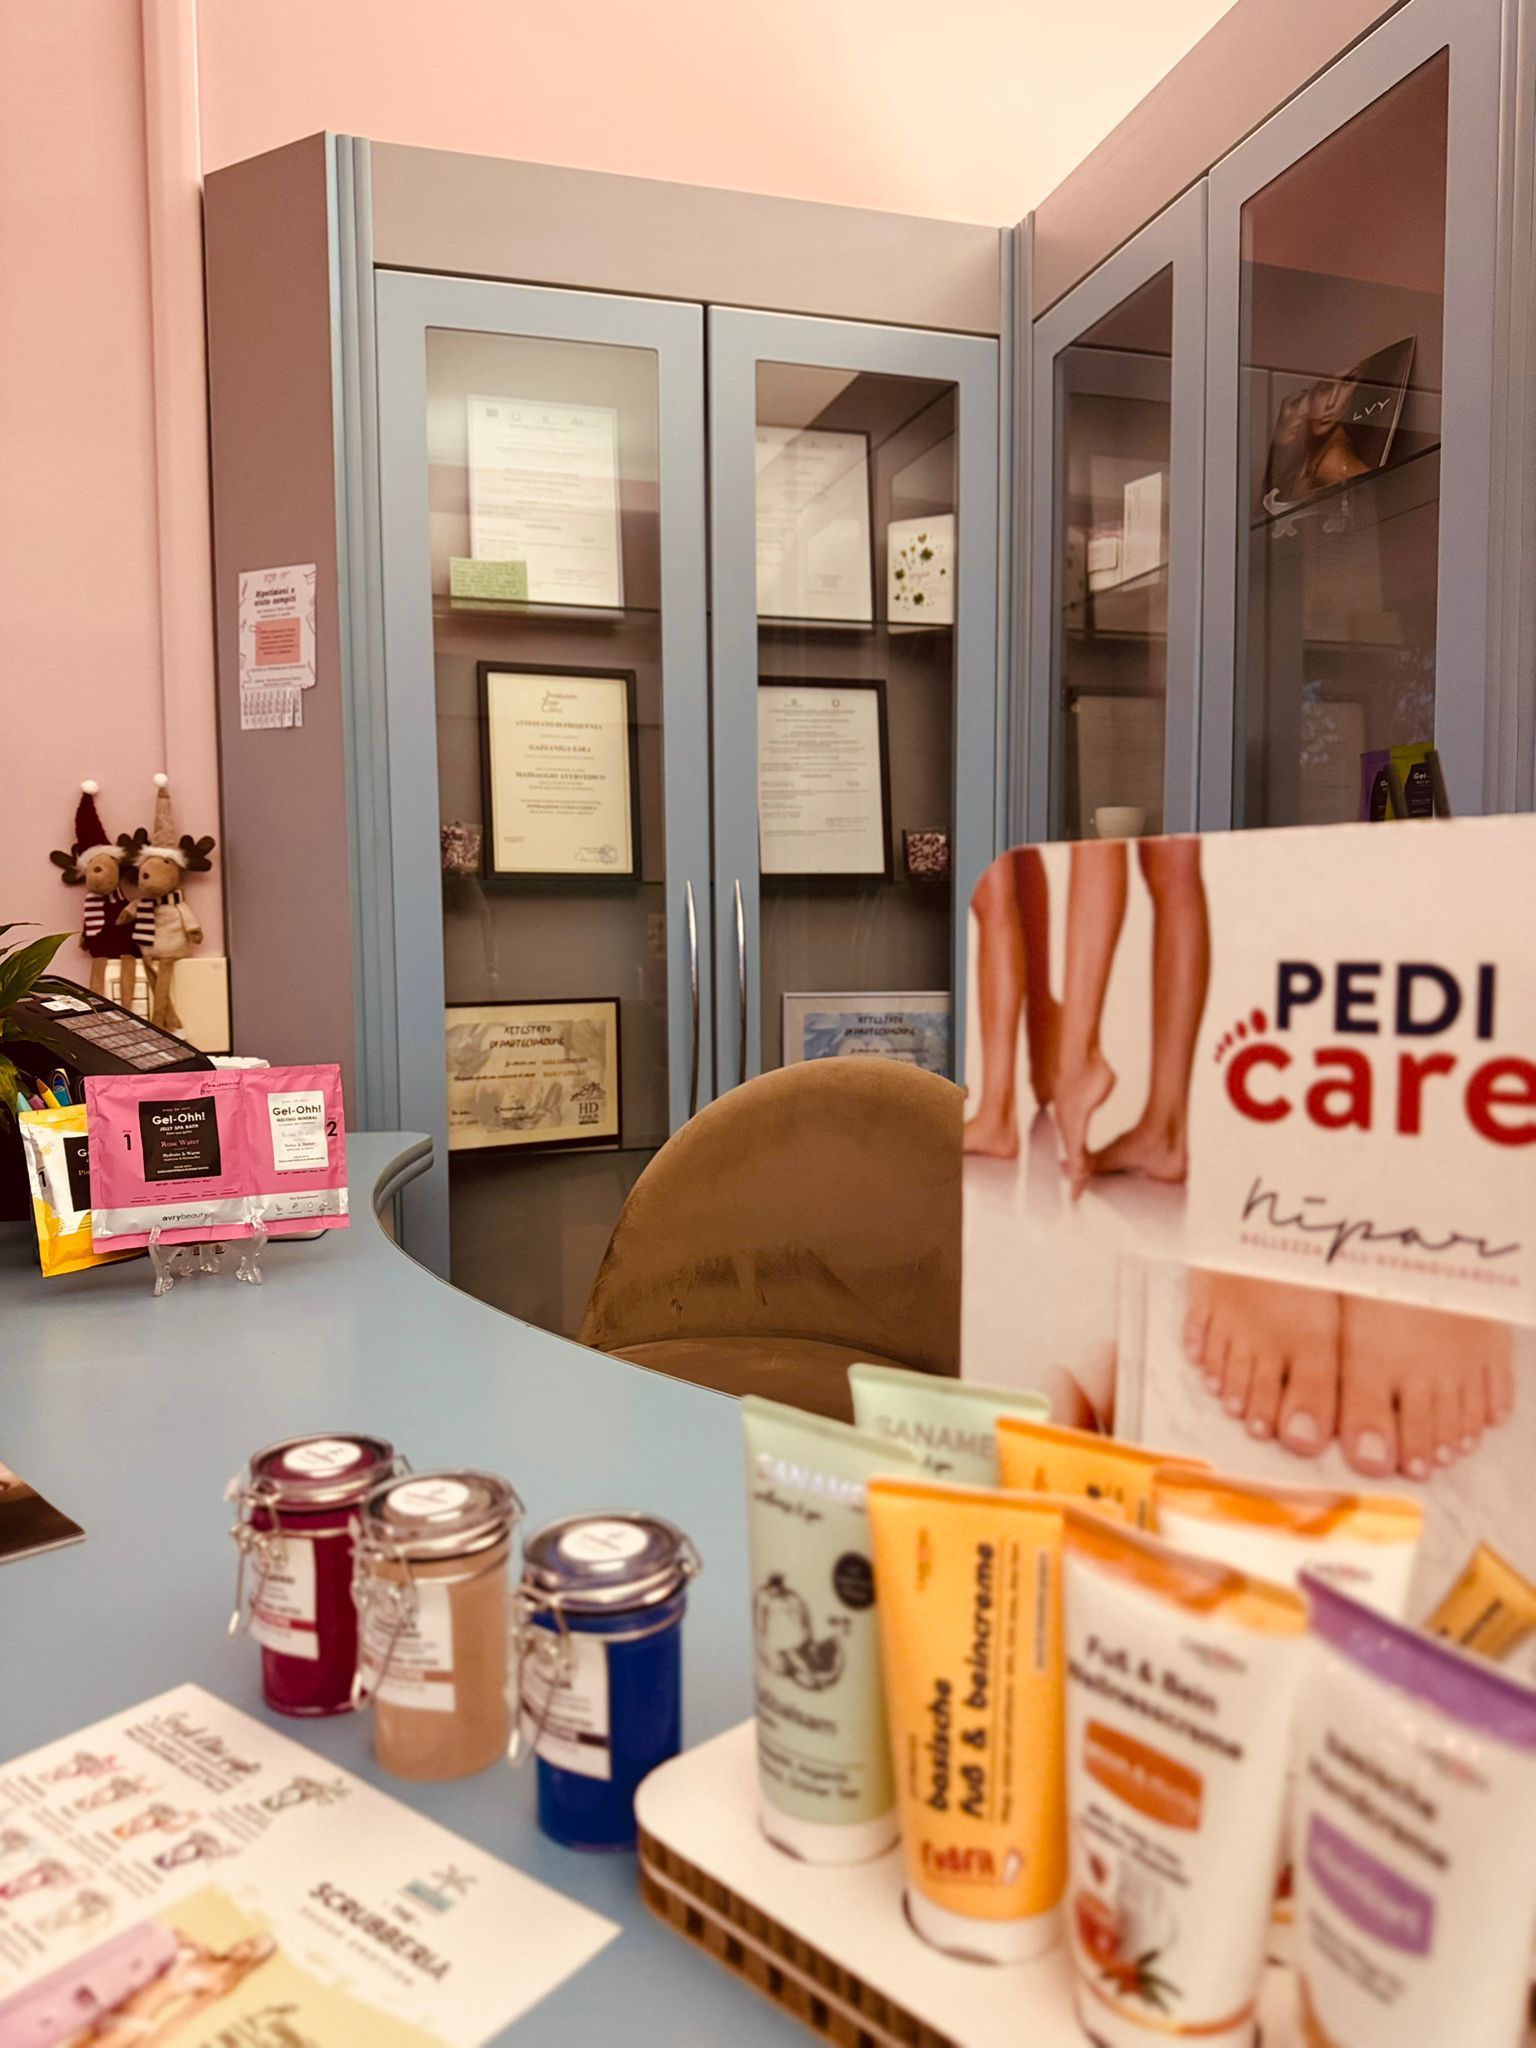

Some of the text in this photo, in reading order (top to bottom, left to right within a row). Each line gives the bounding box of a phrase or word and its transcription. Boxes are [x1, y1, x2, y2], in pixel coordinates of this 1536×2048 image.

[1276, 960, 1496, 1041] PEDI
[504, 1025, 551, 1035] ATTESTATO
[1225, 1042, 1536, 1148] care
[272, 1105, 321, 1116] Gel-Ohh!
[579, 1102, 598, 1114] HD
[152, 1112, 206, 1125] Gel-Ohh!
[326, 1121, 338, 1137] 2
[123, 1134, 131, 1151] 1
[38, 1171, 46, 1188] 1
[162, 1210, 209, 1222] avrybeauty
[877, 1416, 997, 1460] SANAME
[962, 1542, 995, 1710] beincreme
[925, 1678, 952, 1812] basische
[961, 1726, 987, 1750] &
[308, 1881, 452, 1981] SCRUBBERIA
